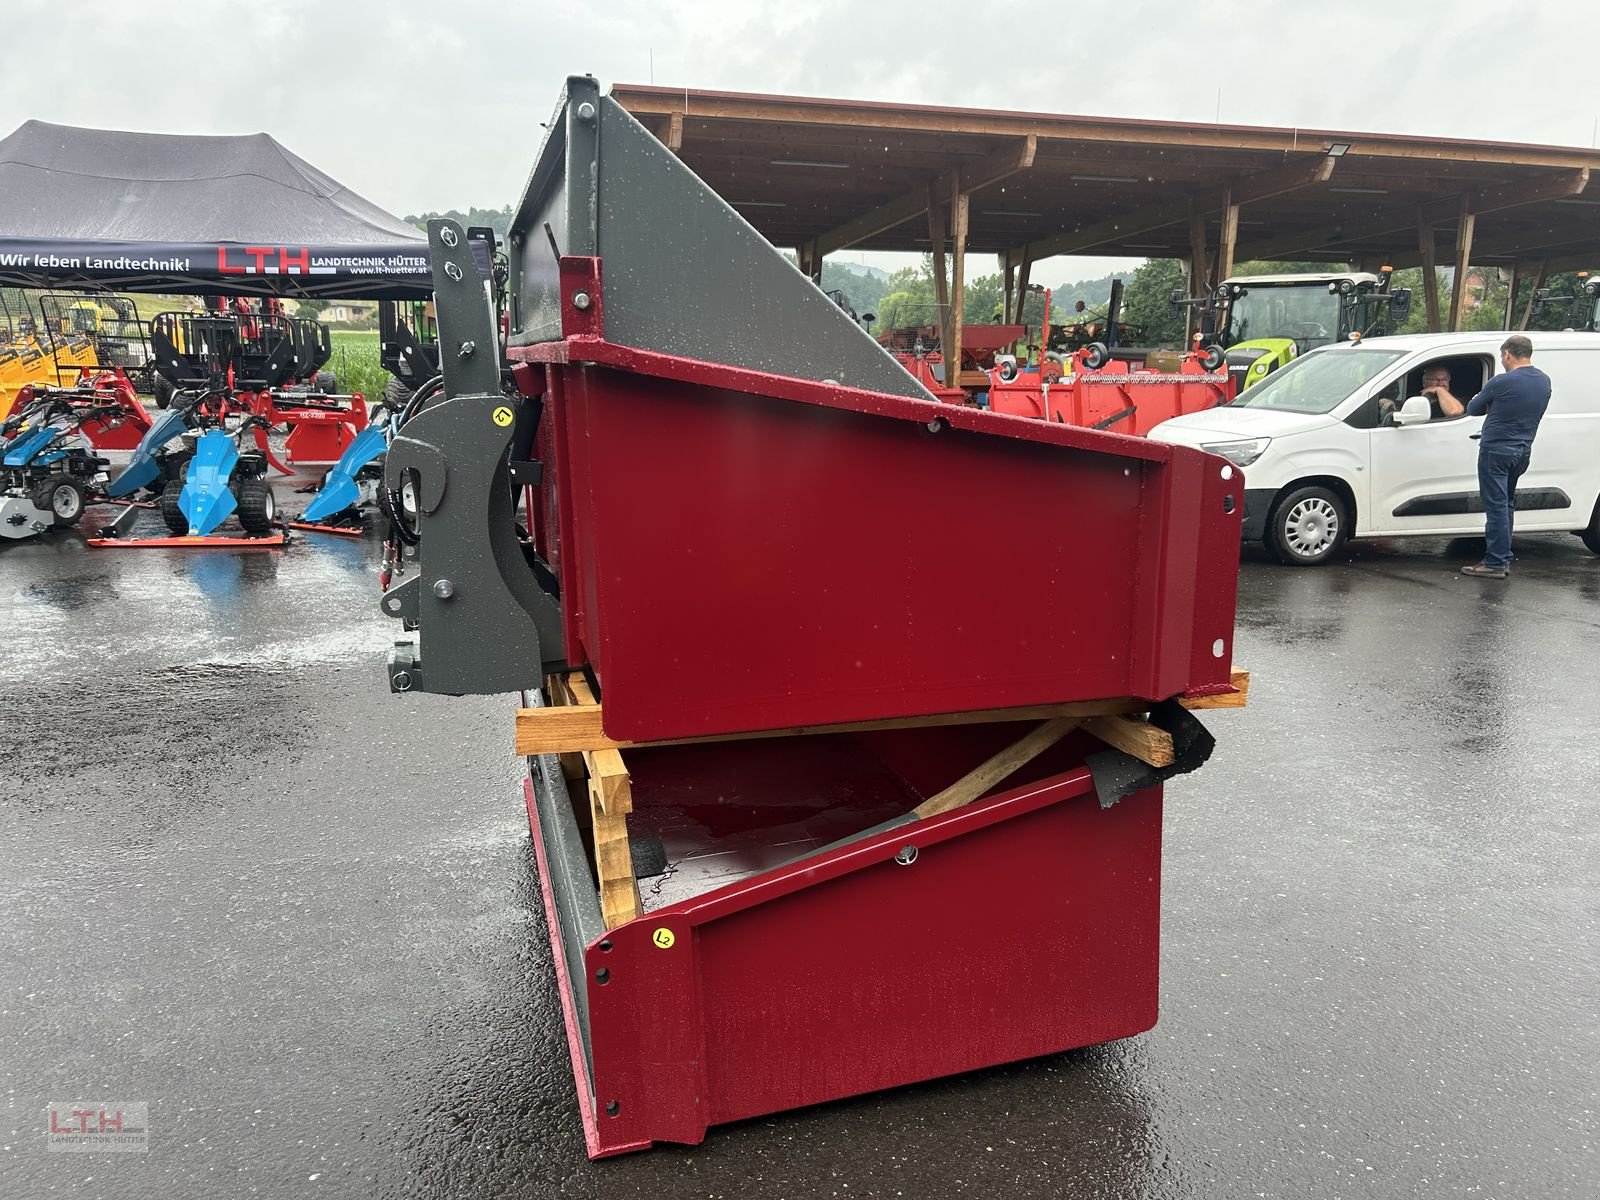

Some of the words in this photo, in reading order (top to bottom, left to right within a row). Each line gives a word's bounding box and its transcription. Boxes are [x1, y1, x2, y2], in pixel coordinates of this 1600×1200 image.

[0, 253, 30, 267] Wir
[34, 254, 81, 268] leben
[85, 256, 190, 272] Landtechnik!
[217, 245, 310, 276] LTH
[311, 257, 386, 267] LANDTECHNIK
[388, 255, 427, 267] HÜTTER
[350, 266, 427, 275] www.lt-huetter.at
[656, 931, 671, 946] L2
